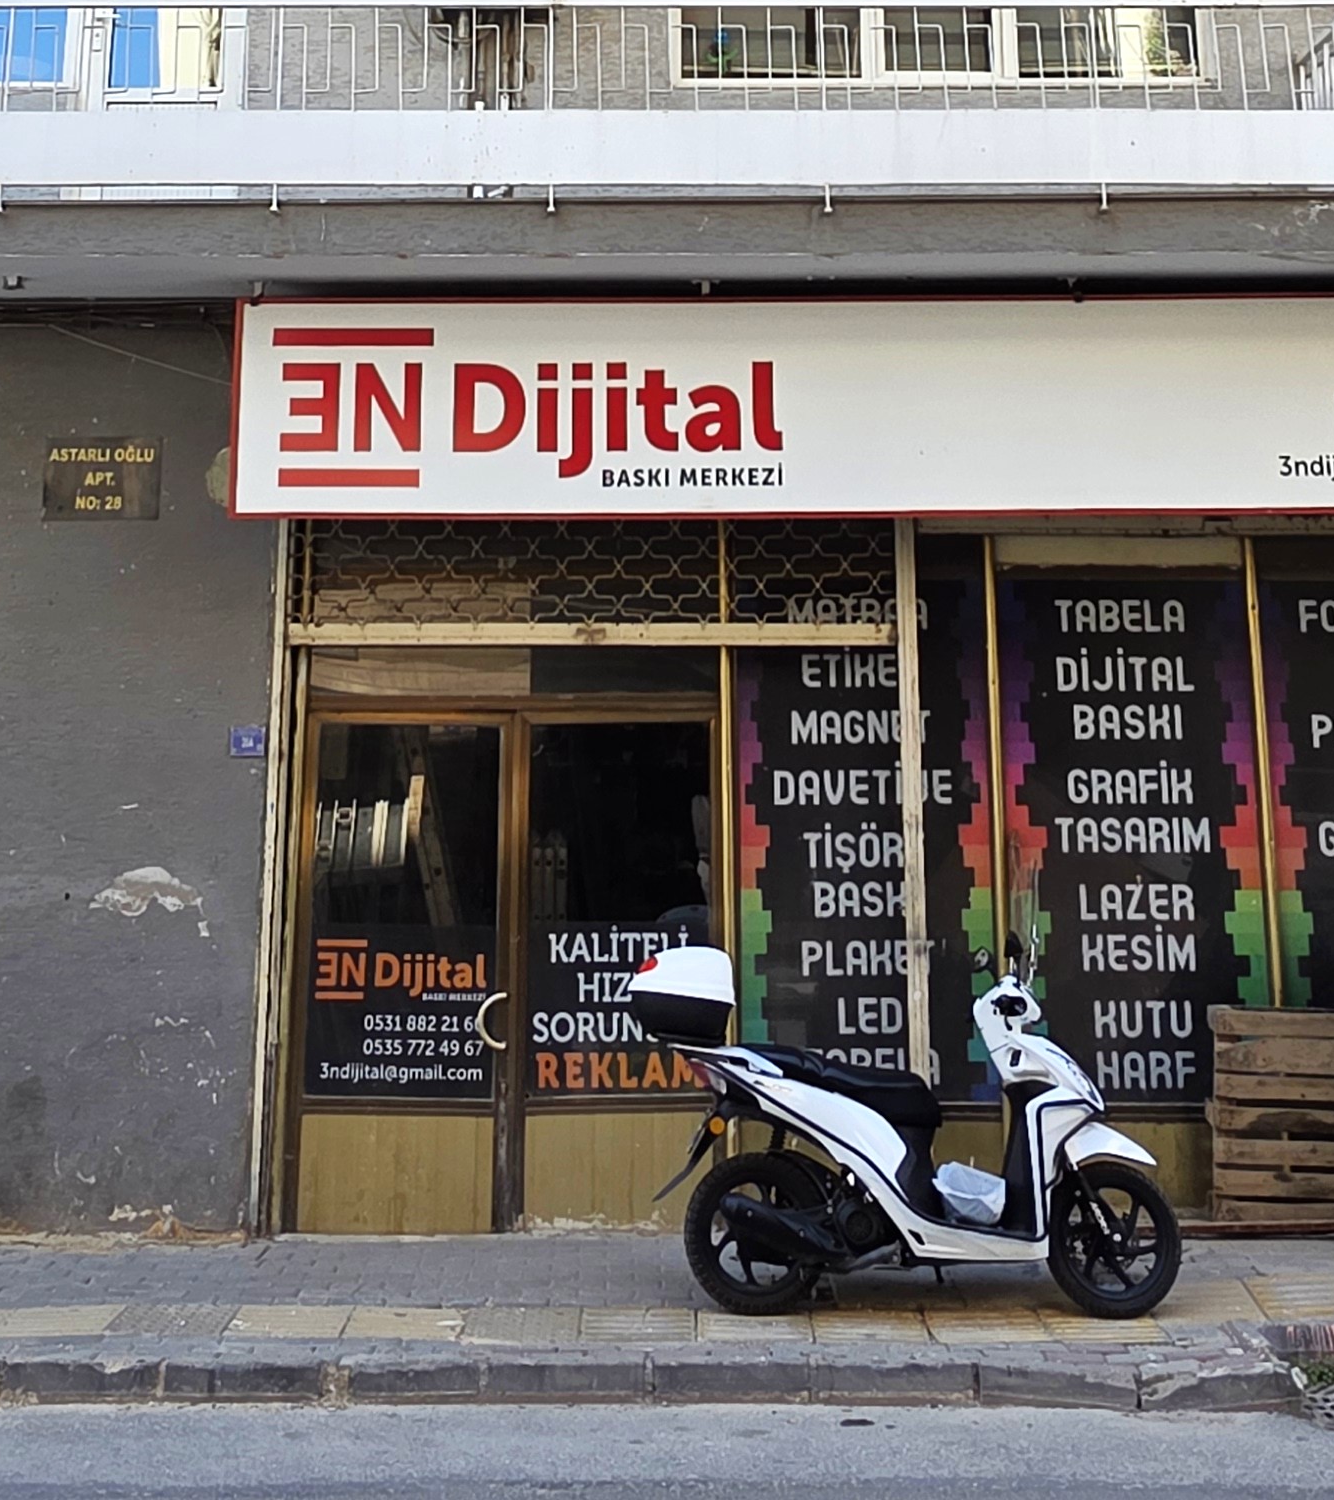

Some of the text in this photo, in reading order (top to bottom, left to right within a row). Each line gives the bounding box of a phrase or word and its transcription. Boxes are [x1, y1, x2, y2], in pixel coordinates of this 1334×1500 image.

[452, 360, 784, 479] Dijital
[49, 445, 155, 463] ASTARLI OĞLU
[84, 471, 115, 487] APT.
[600, 463, 784, 488] BASKI MERKEZİ
[74, 495, 101, 511] NO:
[1054, 599, 1186, 633] TABELA
[800, 646, 898, 688] ETİKE
[1055, 647, 1195, 693] DİJİTAL
[1073, 704, 1183, 740] BASKI
[1067, 759, 1194, 805] GRAFİK
[802, 821, 905, 874] TİŞÖR
[1054, 817, 1211, 855] TASARIM
[813, 880, 907, 918] BASK
[1079, 883, 1195, 921] LAZER
[1081, 924, 1197, 973] KESİM
[373, 952, 487, 997] Dijital
[576, 971, 634, 1003] HIZ
[363, 1014, 403, 1032] 0531
[406, 1014, 437, 1032] 882
[440, 1015, 460, 1032] 21
[532, 1011, 659, 1043] SORUN
[836, 997, 904, 1035] LED
[1094, 1000, 1193, 1038] KUTU
[362, 1038, 485, 1057] 0535 772 49 67
[319, 1062, 483, 1084] 3ndijital@gmail.com
[1096, 1051, 1196, 1090] HARF
